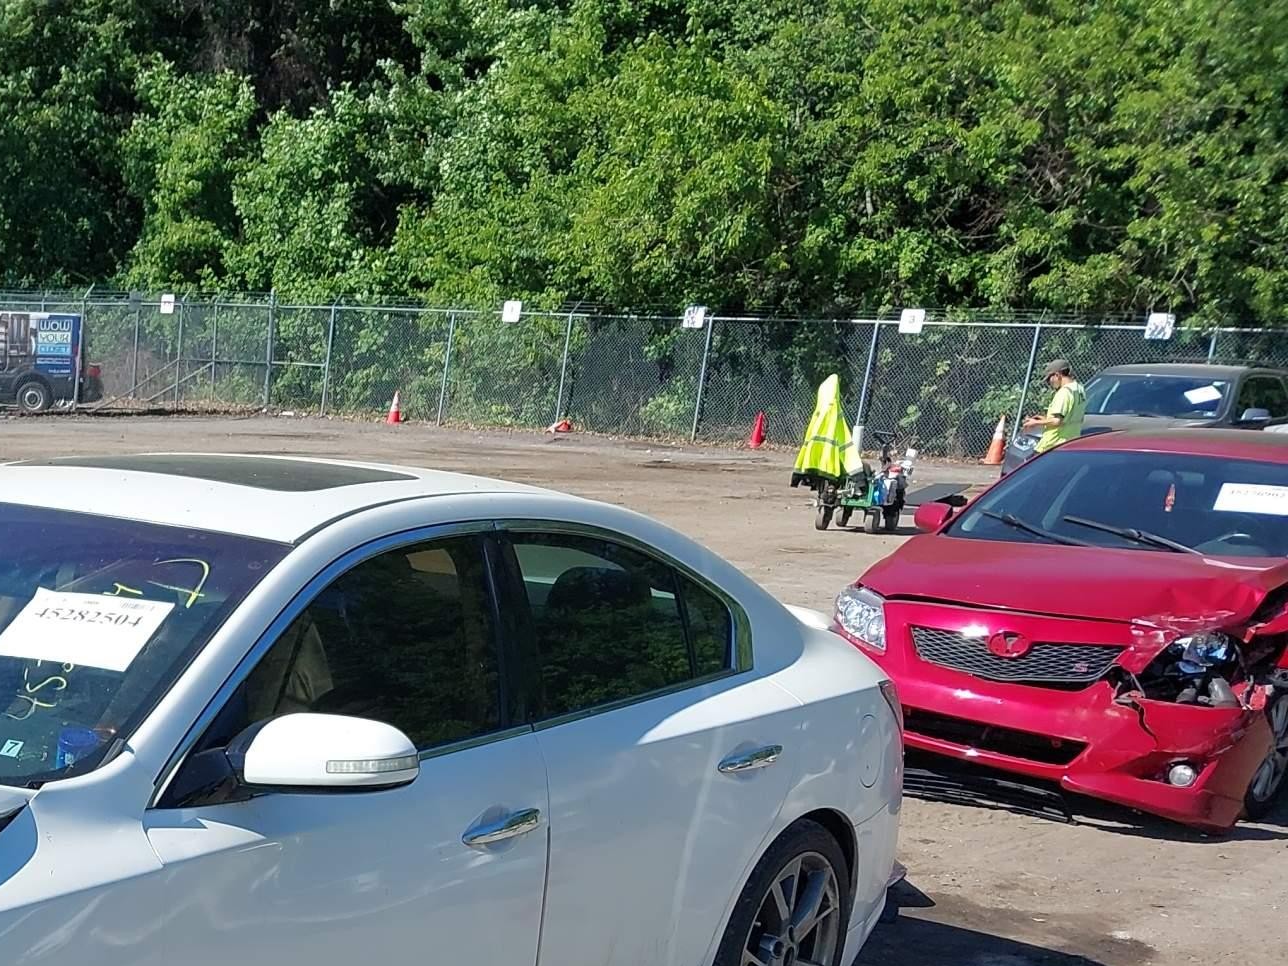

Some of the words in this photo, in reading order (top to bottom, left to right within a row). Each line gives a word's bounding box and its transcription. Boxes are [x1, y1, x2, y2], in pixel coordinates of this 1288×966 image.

[39, 319, 70, 331] WOW
[34, 607, 144, 628] 45282504
[5, 741, 20, 753] 7
